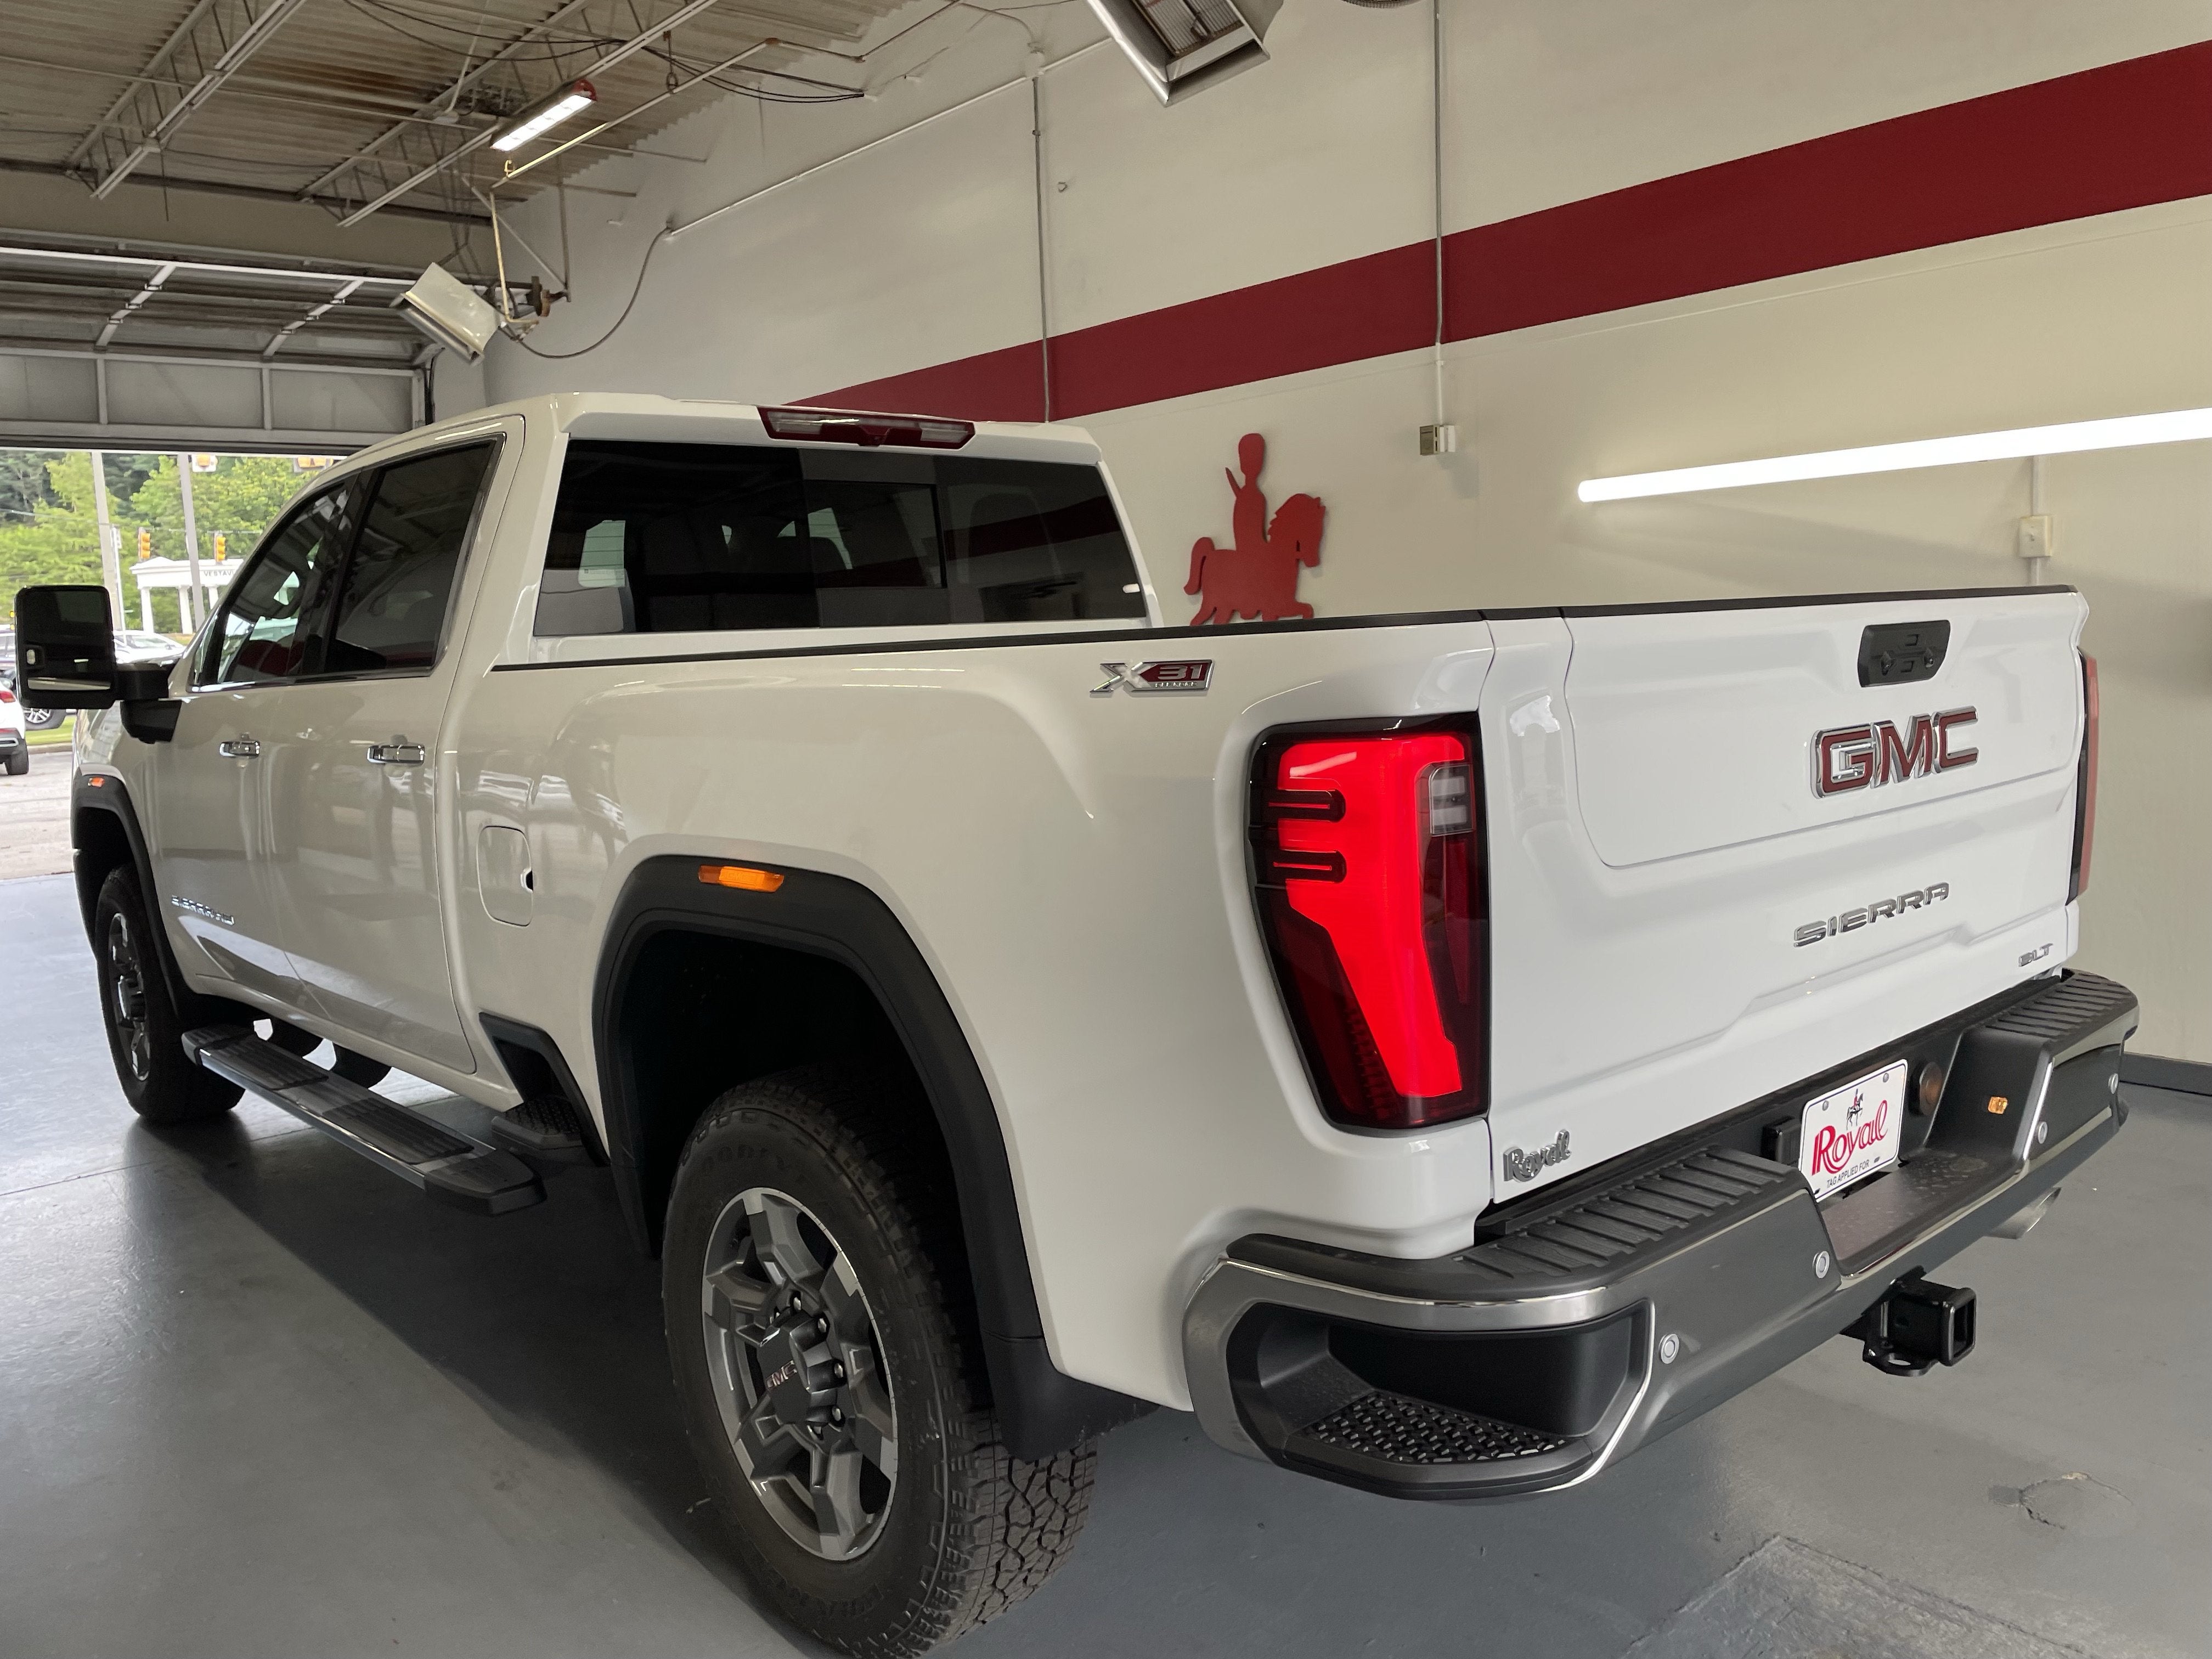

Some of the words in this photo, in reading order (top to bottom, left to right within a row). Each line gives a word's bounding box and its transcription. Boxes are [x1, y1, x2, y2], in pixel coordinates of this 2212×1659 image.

[1090, 659, 1203, 692] X31
[1811, 706, 1978, 798] GMC
[1794, 881, 1950, 948] SIERRA
[2018, 943, 2053, 967] SLT
[1503, 1128, 1572, 1183] Royal
[1812, 1099, 1888, 1176] Royal
[1826, 1176, 1837, 1188] TAG
[1837, 1165, 1859, 1183] APPLIED
[1859, 1159, 1870, 1171] FOR
[766, 1360, 797, 1389] GMC
